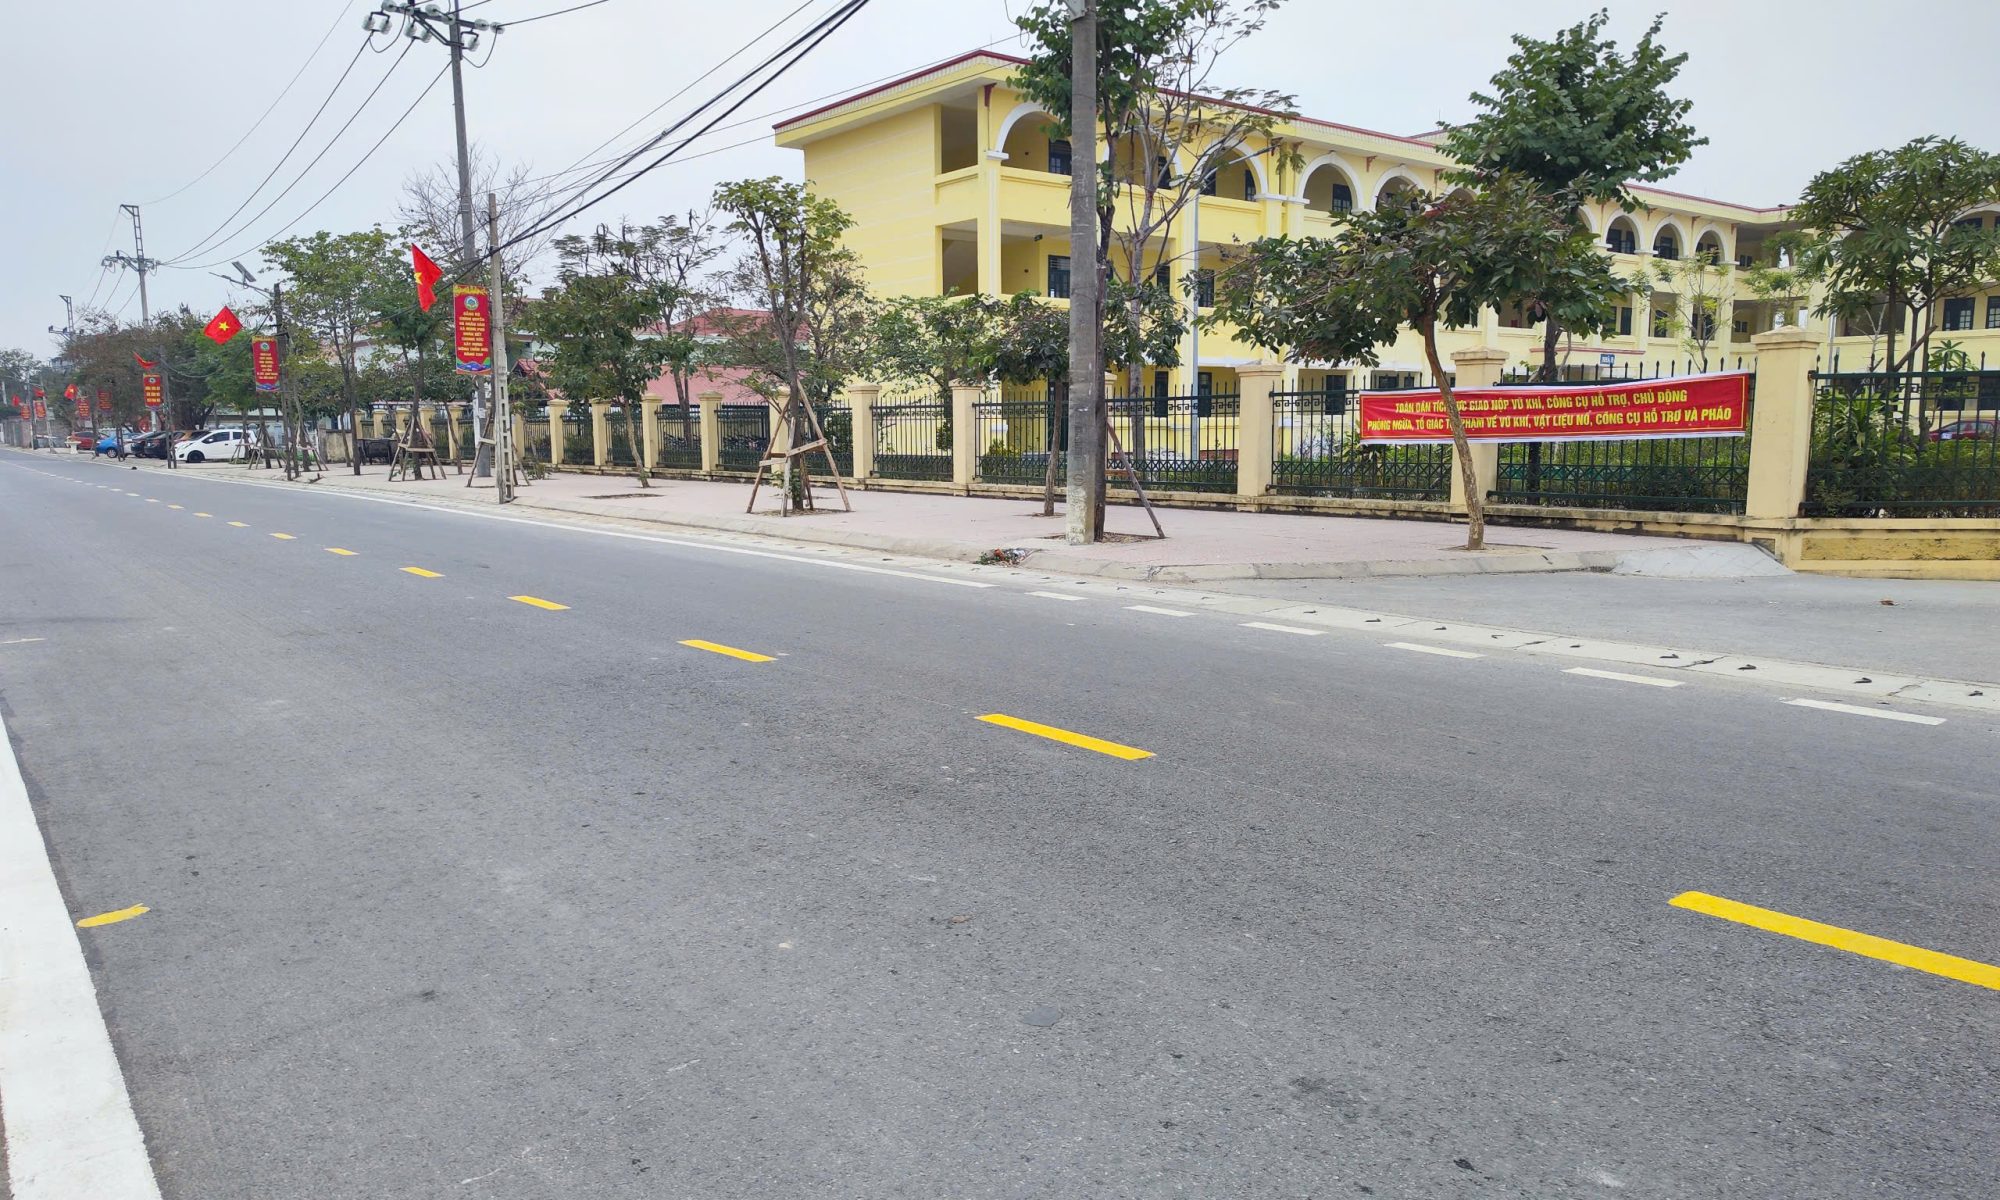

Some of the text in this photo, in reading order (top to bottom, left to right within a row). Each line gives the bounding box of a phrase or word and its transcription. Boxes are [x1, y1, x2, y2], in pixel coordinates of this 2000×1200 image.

[1415, 400, 1431, 412] DÂN
[1432, 400, 1447, 412] TÍC
[1469, 399, 1489, 411] GIAO
[1491, 397, 1509, 412] NỘP
[1511, 397, 1524, 409] VŨ
[1526, 396, 1545, 410] KHÍ,
[1546, 395, 1573, 408] CÔNG
[1575, 396, 1588, 409] CỤ
[1591, 391, 1605, 407] HỖ
[1607, 393, 1631, 407] TRỢ,
[1633, 388, 1655, 404] CHỦ
[1657, 388, 1688, 405] ĐỘNG
[1415, 415, 1425, 430] TỐ
[1426, 418, 1444, 430] GIÁC
[1499, 414, 1511, 428] VŨ
[1513, 414, 1531, 429] KHÍ,
[1533, 413, 1551, 429] VẬT
[1552, 412, 1574, 428] LIỆU
[1596, 411, 1624, 425] CÔNG
[1626, 411, 1641, 426] CỤ
[1643, 407, 1658, 423] HỖ
[1660, 409, 1682, 424] TRỢ
[1684, 406, 1698, 421] VÀ
[1701, 406, 1732, 421] PHÁO
